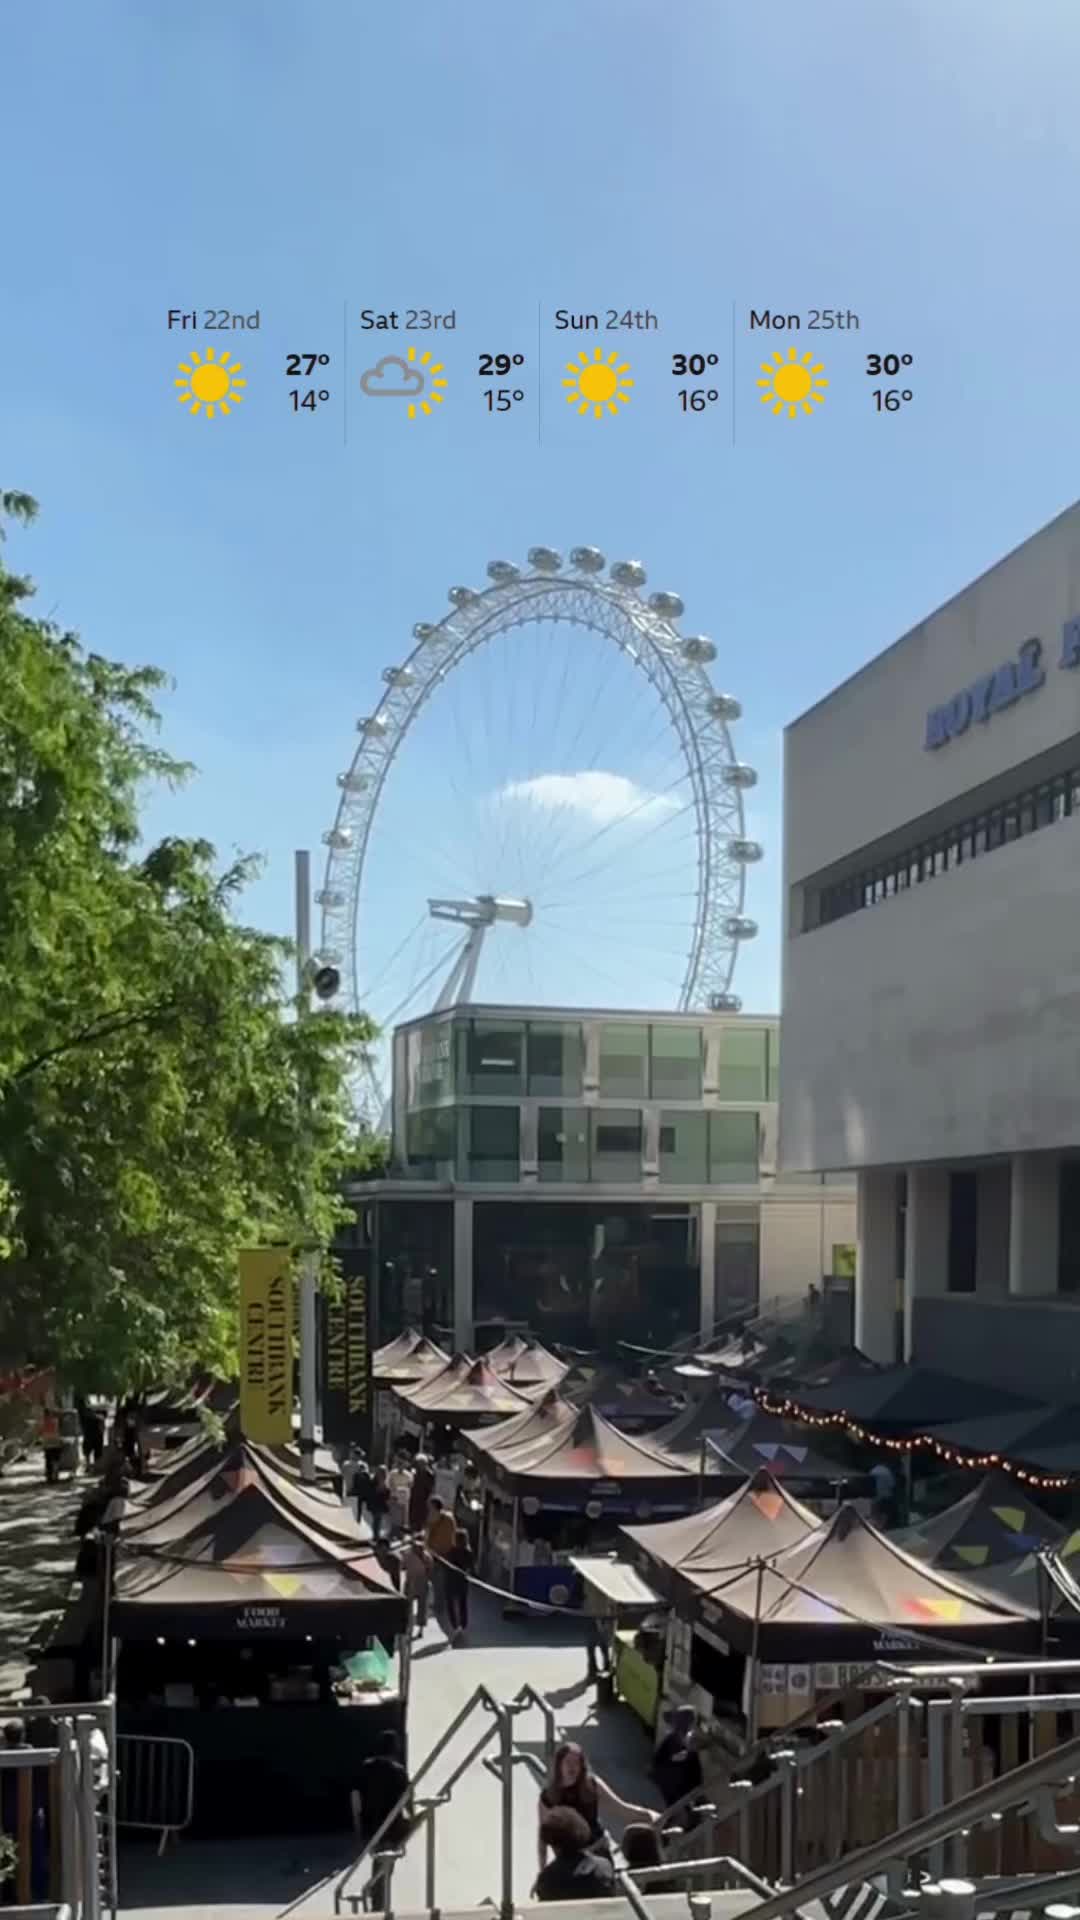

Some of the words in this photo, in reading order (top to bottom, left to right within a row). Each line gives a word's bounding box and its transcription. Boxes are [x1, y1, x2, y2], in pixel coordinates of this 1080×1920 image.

[924, 637, 1046, 752] ROYAL
[247, 1302, 265, 1389] CENTRE
[267, 1275, 286, 1416] SOUTHBANK
[327, 1302, 346, 1390] CENTRE
[348, 1275, 367, 1414] SOUTHBANK
